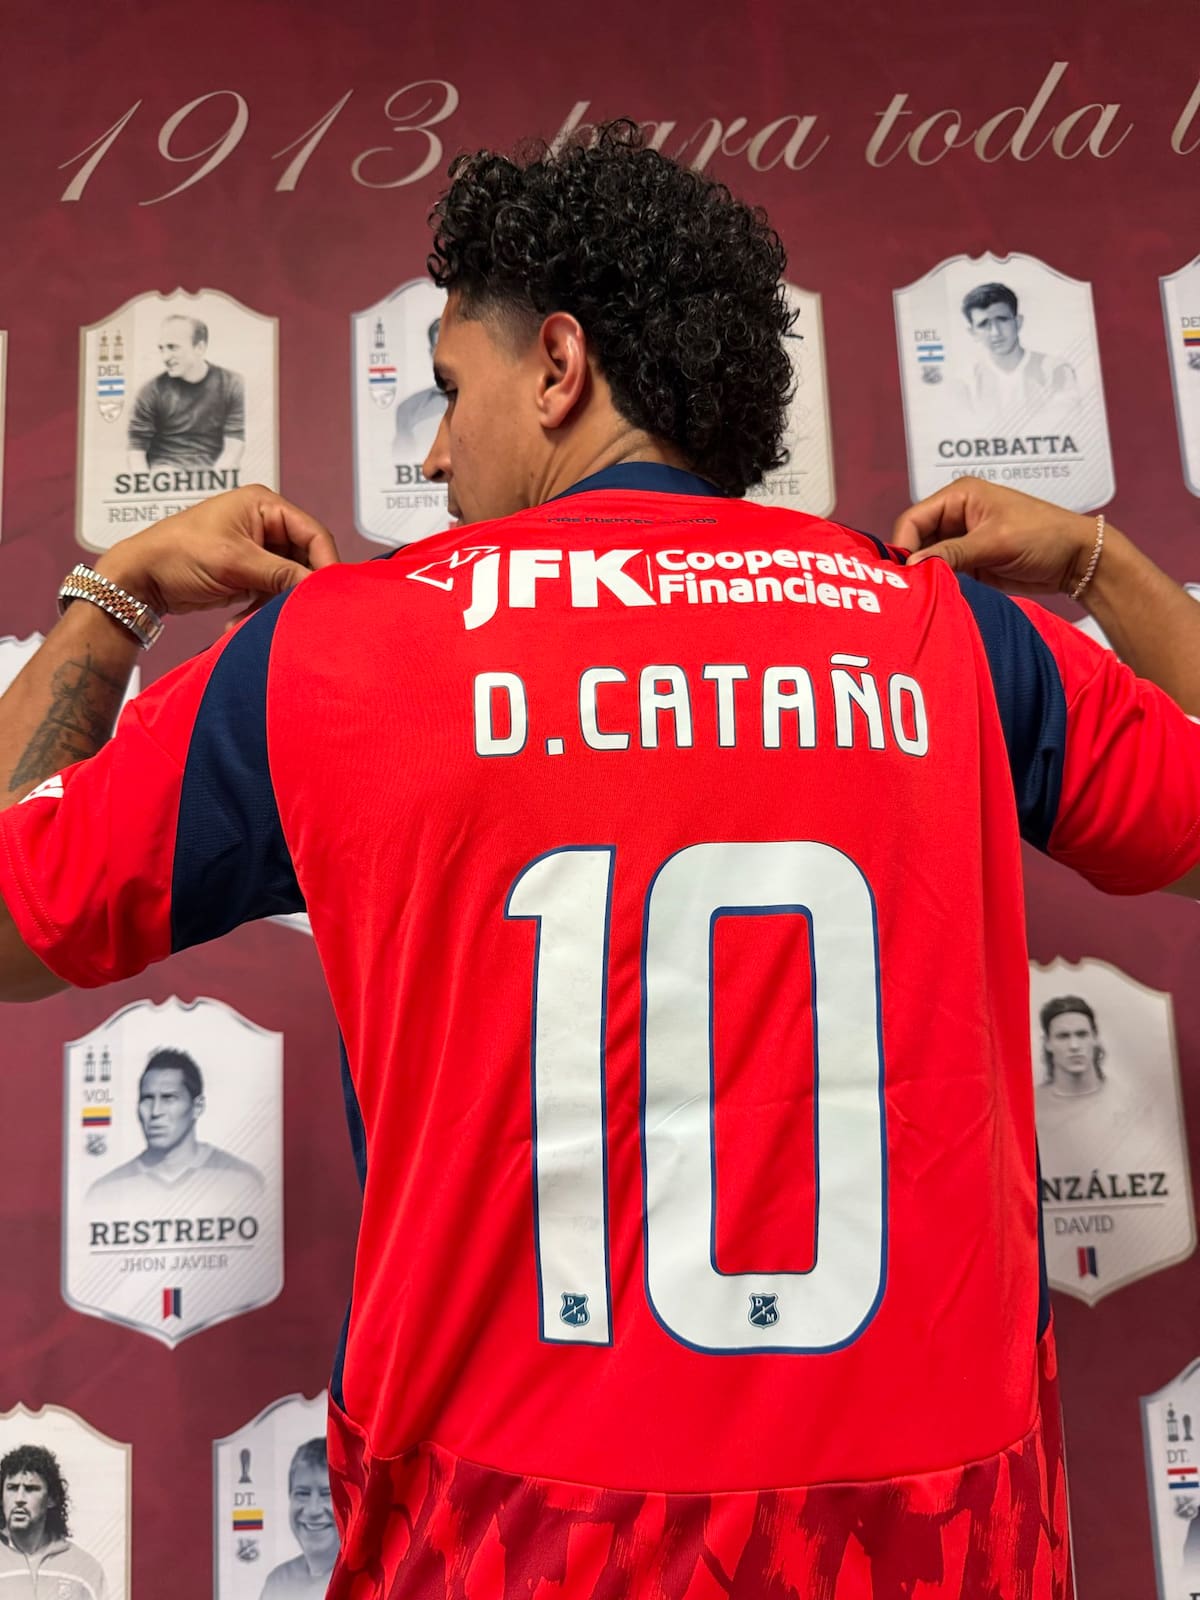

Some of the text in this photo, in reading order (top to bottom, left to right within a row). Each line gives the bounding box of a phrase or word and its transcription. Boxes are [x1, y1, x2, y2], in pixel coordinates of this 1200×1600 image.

[58, 80, 459, 206] 1913
[864, 61, 1133, 168] toda
[914, 330, 940, 342] DEL
[97, 364, 123, 377] DEL
[938, 436, 1079, 459] CORBATTA
[115, 469, 240, 494] SEGHINI
[1002, 465, 1070, 480] ORESTES
[109, 504, 159, 523] RENÉ
[655, 549, 909, 589] Cooperativa
[463, 548, 657, 631] JFK
[658, 572, 881, 614] Financiera
[504, 840, 888, 1357] 10
[1041, 1168, 1169, 1202] NZÁLEZ
[89, 1215, 259, 1246] RESTREPO
[1054, 1214, 1114, 1235] DAVID
[120, 1254, 229, 1273] JHON JAVIER
